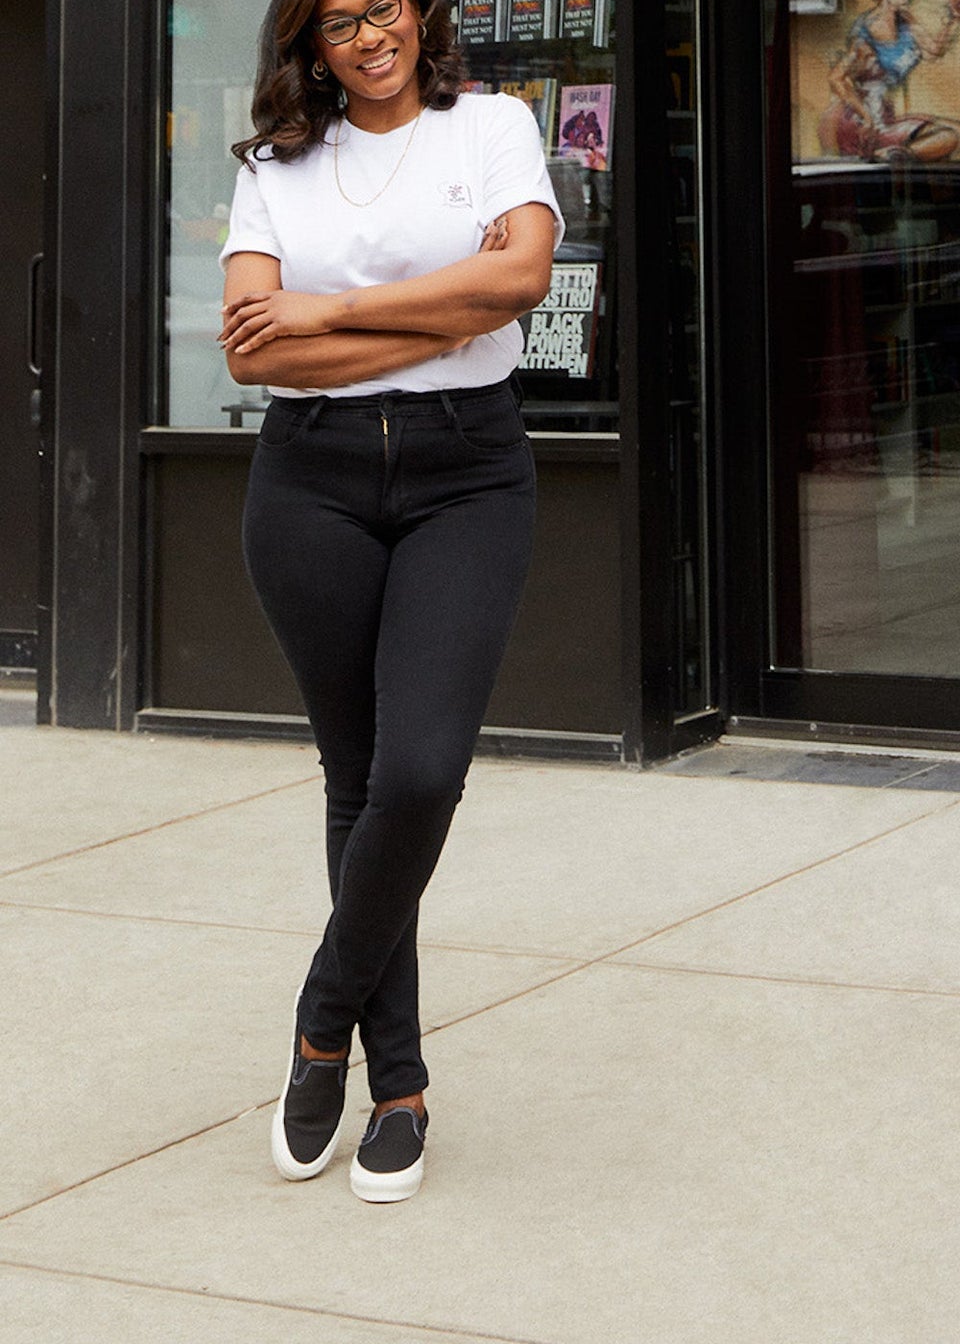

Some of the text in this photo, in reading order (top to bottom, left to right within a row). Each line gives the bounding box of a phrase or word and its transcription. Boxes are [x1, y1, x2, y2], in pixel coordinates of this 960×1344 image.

[550, 267, 592, 287] ETTO
[542, 287, 591, 308] ASTRO
[530, 313, 586, 335] BLACK
[526, 333, 583, 355] POWER
